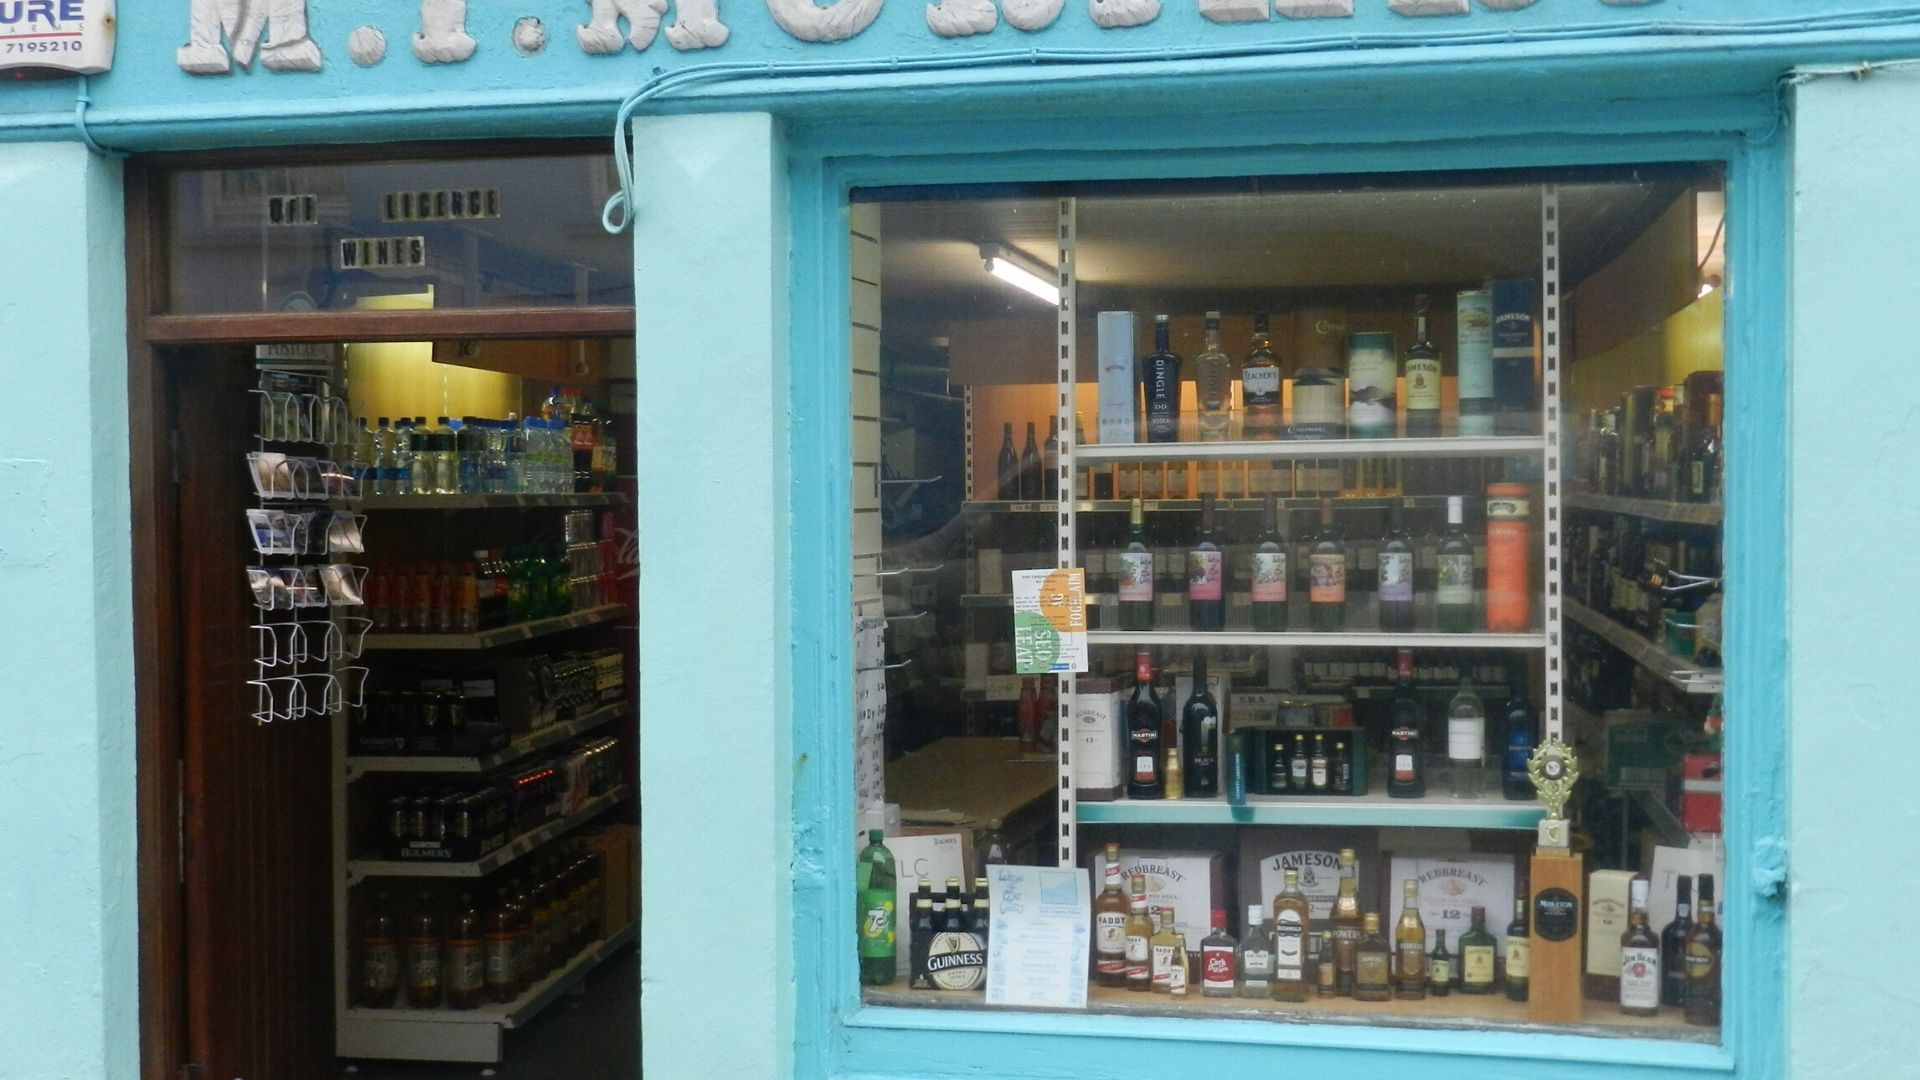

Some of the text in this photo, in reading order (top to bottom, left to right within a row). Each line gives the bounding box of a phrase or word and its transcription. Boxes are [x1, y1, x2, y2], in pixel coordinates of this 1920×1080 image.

[6, 41, 82, 53] 7195210
[269, 189, 496, 223] OFF LICENCE
[342, 239, 423, 267] WINES
[1495, 311, 1531, 323] JAMESON
[1155, 359, 1166, 399] DINGLE
[400, 847, 452, 859] BULMERS
[1273, 852, 1342, 871] JAMESON
[1121, 863, 1186, 882] REDBREAST
[1418, 866, 1488, 887] REDBREAST
[1098, 916, 1127, 925] PADDY
[1441, 909, 1462, 920] 12
[927, 952, 983, 971] GUINNESS
